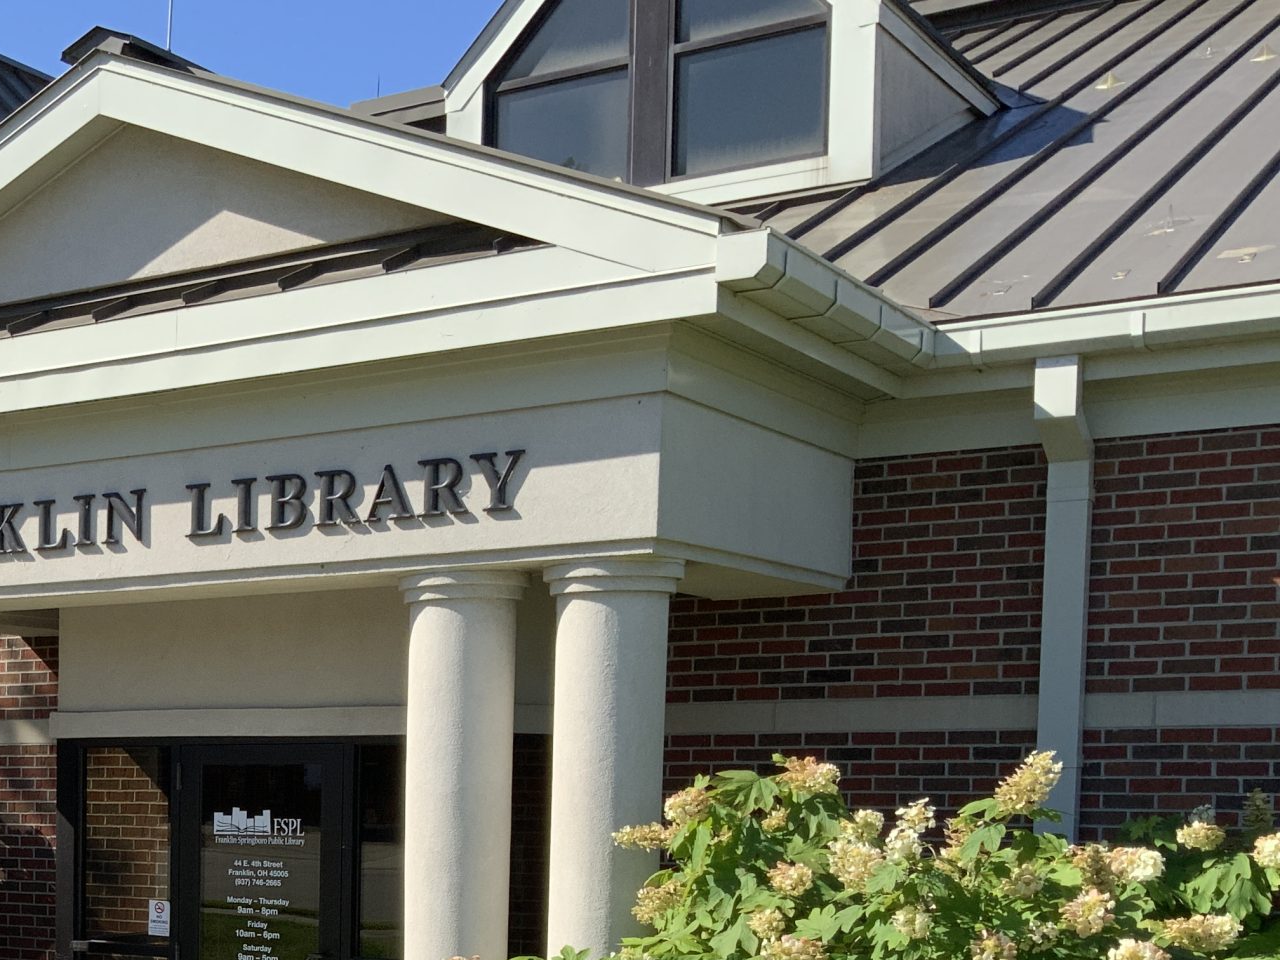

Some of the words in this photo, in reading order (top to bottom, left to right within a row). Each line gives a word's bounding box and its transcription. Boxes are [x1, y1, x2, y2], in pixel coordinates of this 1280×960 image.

[185, 449, 526, 539] LIBRARY
[273, 818, 305, 836] FSPL
[268, 837, 284, 845] Public
[285, 838, 305, 847] Library
[263, 860, 283, 868] Street
[228, 868, 256, 877] Franklin,
[257, 869, 268, 877] OH
[269, 870, 289, 878] 45005
[235, 878, 251, 886] (937)
[226, 896, 253, 905] Monday
[258, 897, 289, 907] Thursday
[237, 906, 254, 914] 9am
[261, 907, 278, 916] 8pm
[247, 920, 268, 929] Friday
[235, 929, 256, 938] 10am
[263, 931, 280, 940] 6pm
[242, 943, 272, 953] Saturday
[237, 953, 254, 960] 9am
